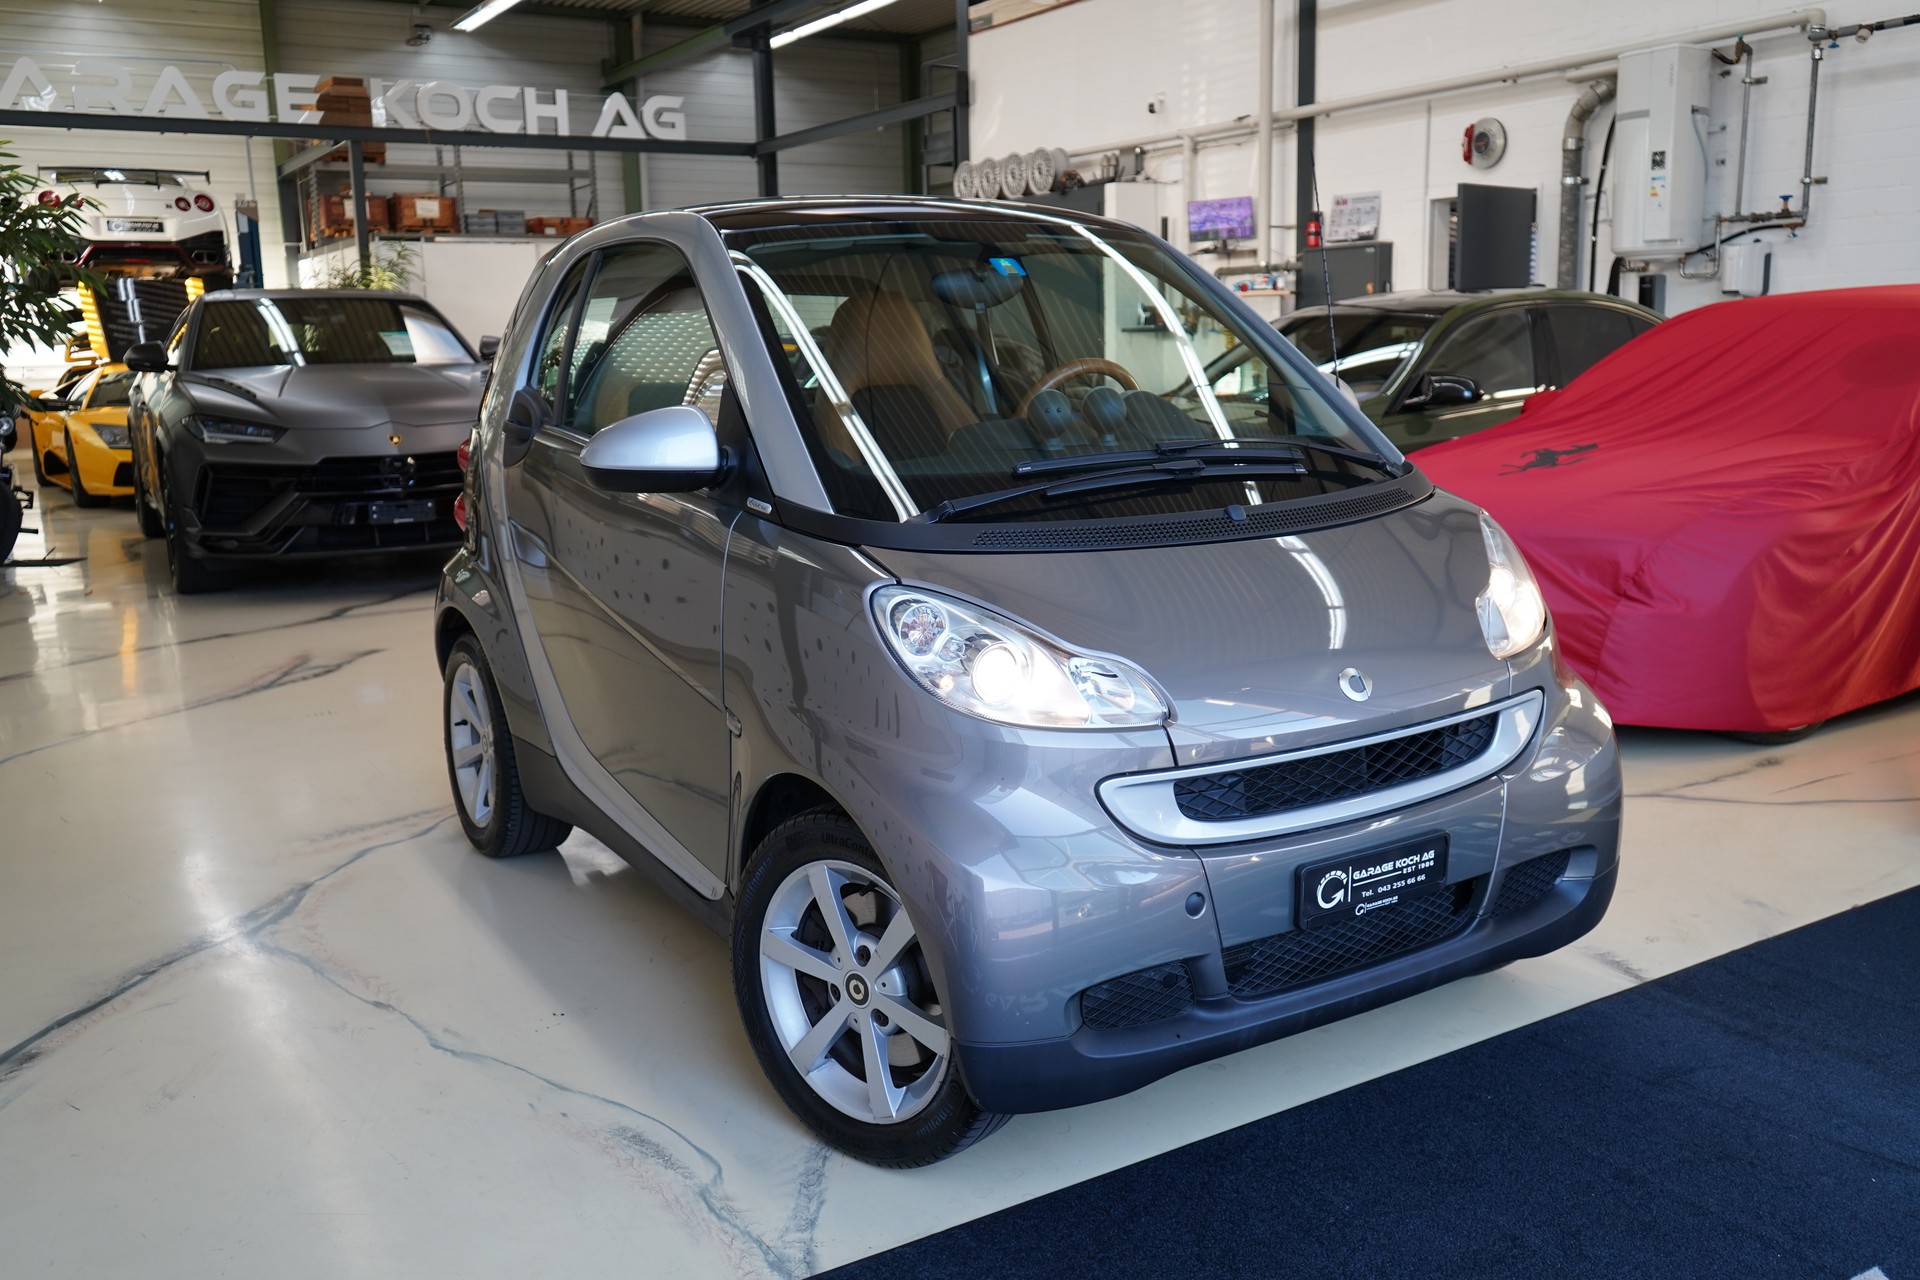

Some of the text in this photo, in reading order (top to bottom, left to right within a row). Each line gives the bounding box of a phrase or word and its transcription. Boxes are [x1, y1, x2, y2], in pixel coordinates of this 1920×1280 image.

[370, 79, 570, 136] KOCH
[592, 92, 686, 140] AG
[1353, 850, 1435, 880] GARAGE KOCH AG
[1403, 860, 1434, 874] EST 1986
[1361, 873, 1426, 898] Tel. 043 255 66 66
